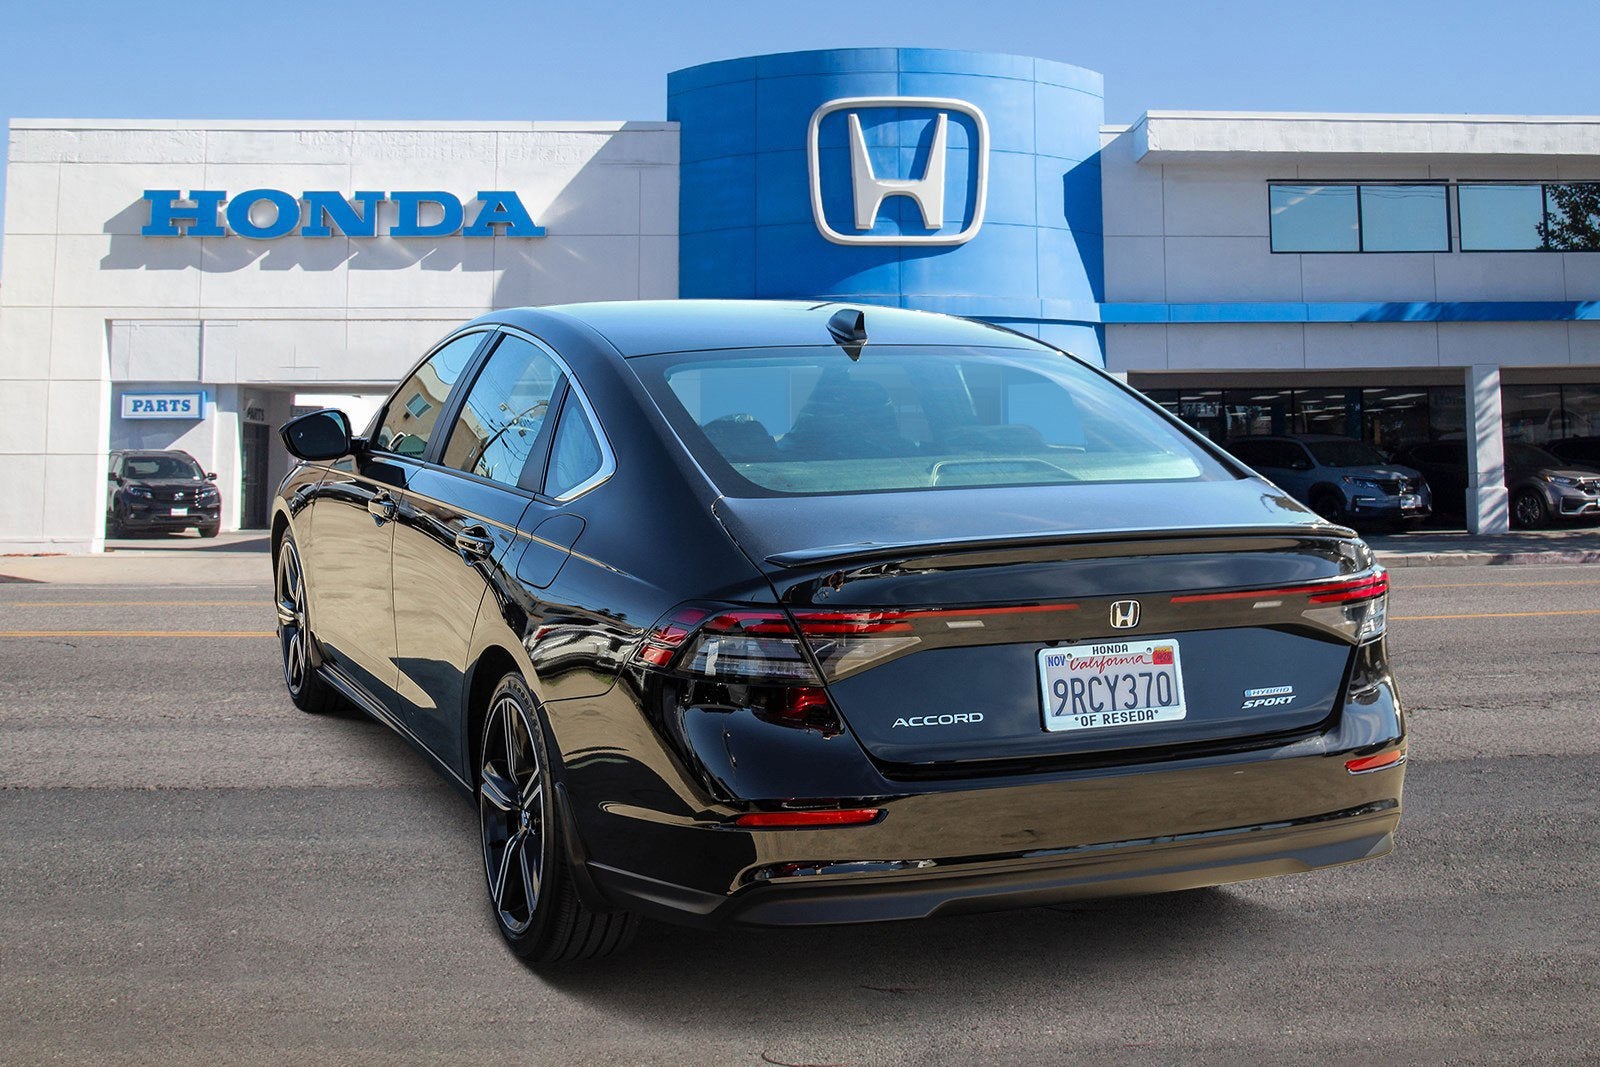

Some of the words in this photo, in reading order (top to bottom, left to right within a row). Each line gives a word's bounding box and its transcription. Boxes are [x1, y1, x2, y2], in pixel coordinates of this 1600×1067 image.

[141, 189, 547, 239] HONDA
[131, 399, 191, 412] PARTS
[1092, 644, 1129, 655] HONDA
[1047, 655, 1065, 667] NOV
[1070, 654, 1152, 674] California
[1053, 671, 1172, 716] 9RCY370
[1252, 687, 1290, 696] HYBRID
[1241, 695, 1297, 709] SPORT
[891, 712, 984, 728] ACCORD
[1081, 715, 1097, 727] OF
[1103, 709, 1154, 725] RESEDA
